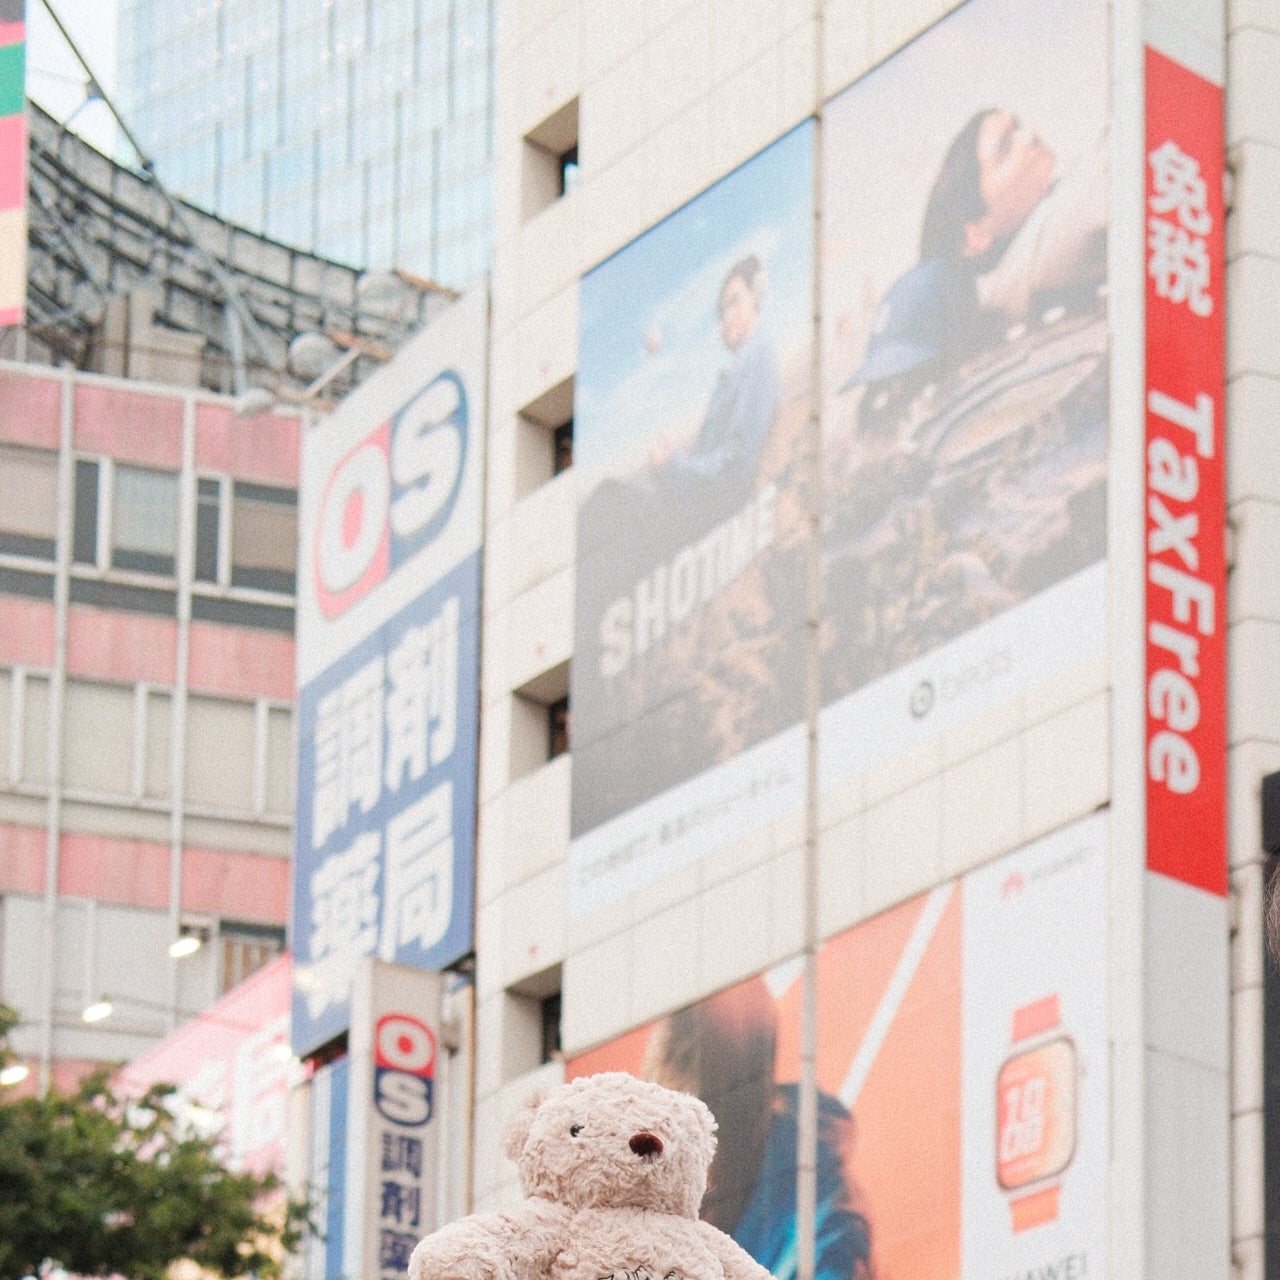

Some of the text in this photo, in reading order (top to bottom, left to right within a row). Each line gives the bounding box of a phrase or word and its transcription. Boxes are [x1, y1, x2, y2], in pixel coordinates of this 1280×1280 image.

[313, 367, 470, 622] OS
[1147, 393, 1215, 796] TaxFree
[374, 1014, 437, 1128] OS
